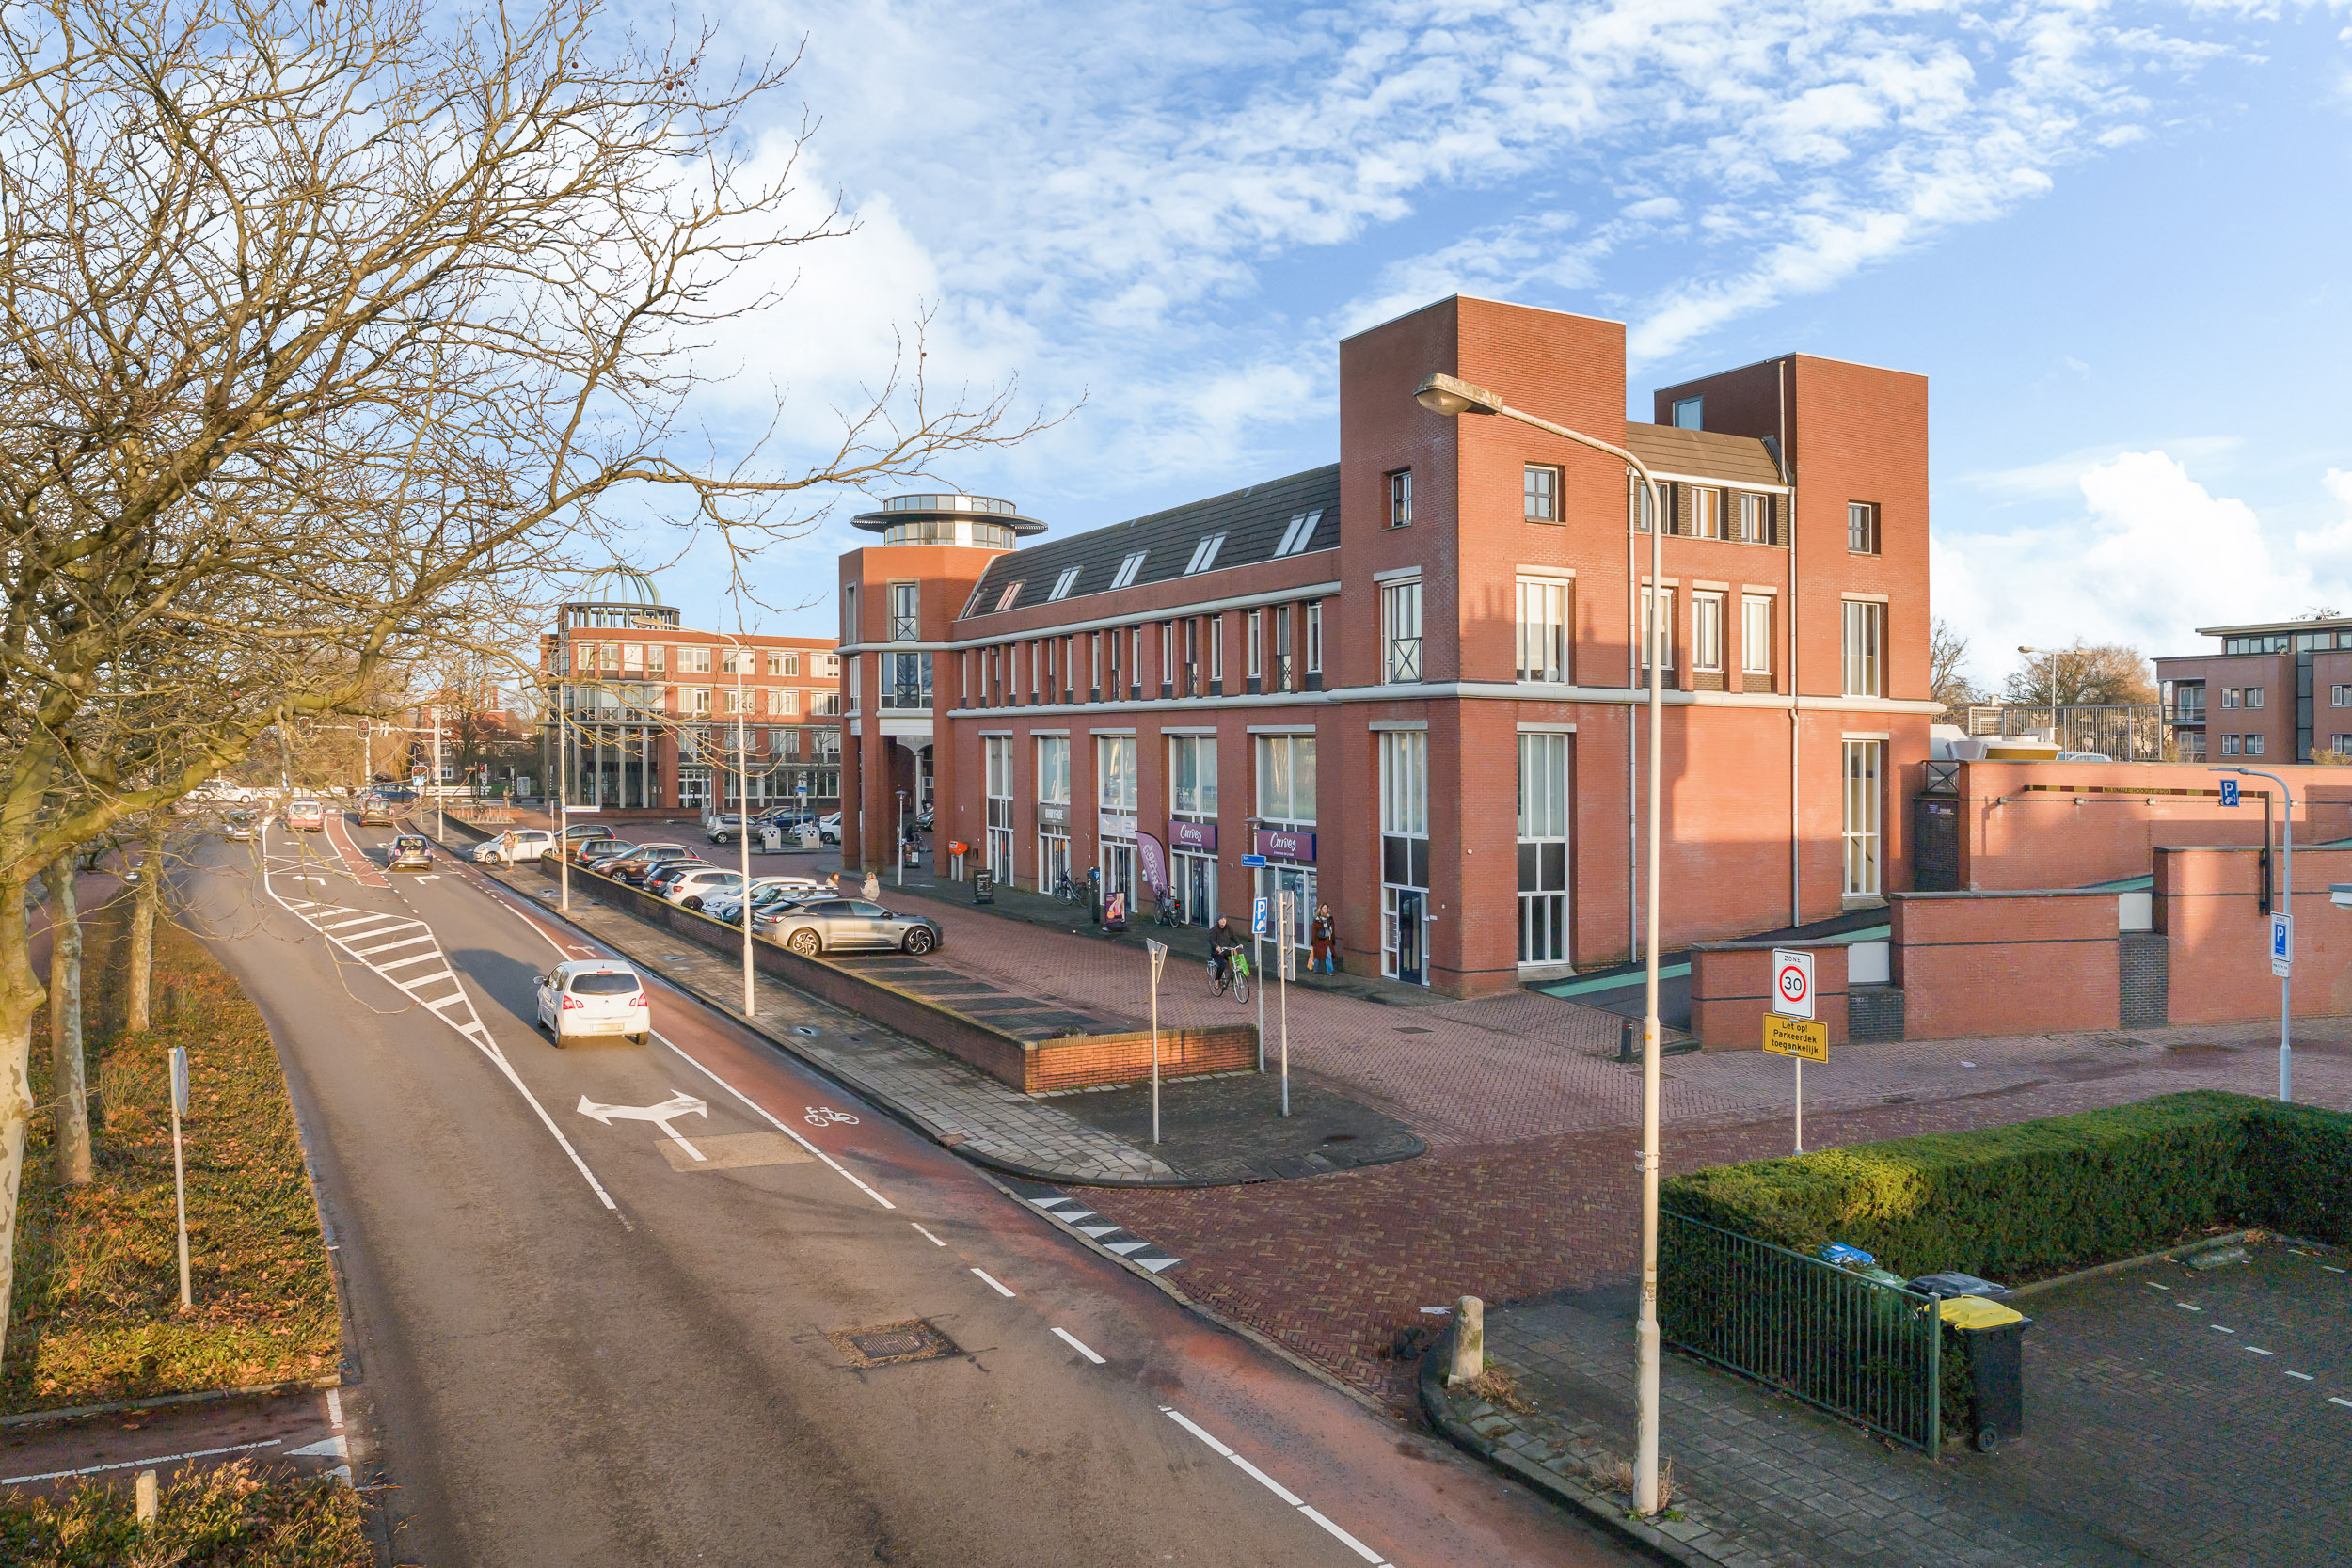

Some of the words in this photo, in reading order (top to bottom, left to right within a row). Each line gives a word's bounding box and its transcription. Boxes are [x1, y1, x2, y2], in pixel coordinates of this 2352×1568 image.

[2224, 783, 2233, 796] P
[1180, 823, 1202, 843] Curves
[1270, 832, 1296, 852] Curves
[1257, 901, 1265, 920] P
[2277, 926, 2284, 942] P
[1784, 976, 1803, 991] 30
[1782, 1021, 1794, 1030] Let
[1797, 1024, 1808, 1033] op!
[1773, 1029, 1818, 1044] Parkeerdek
[1772, 1038, 1819, 1055] toegankelijk
